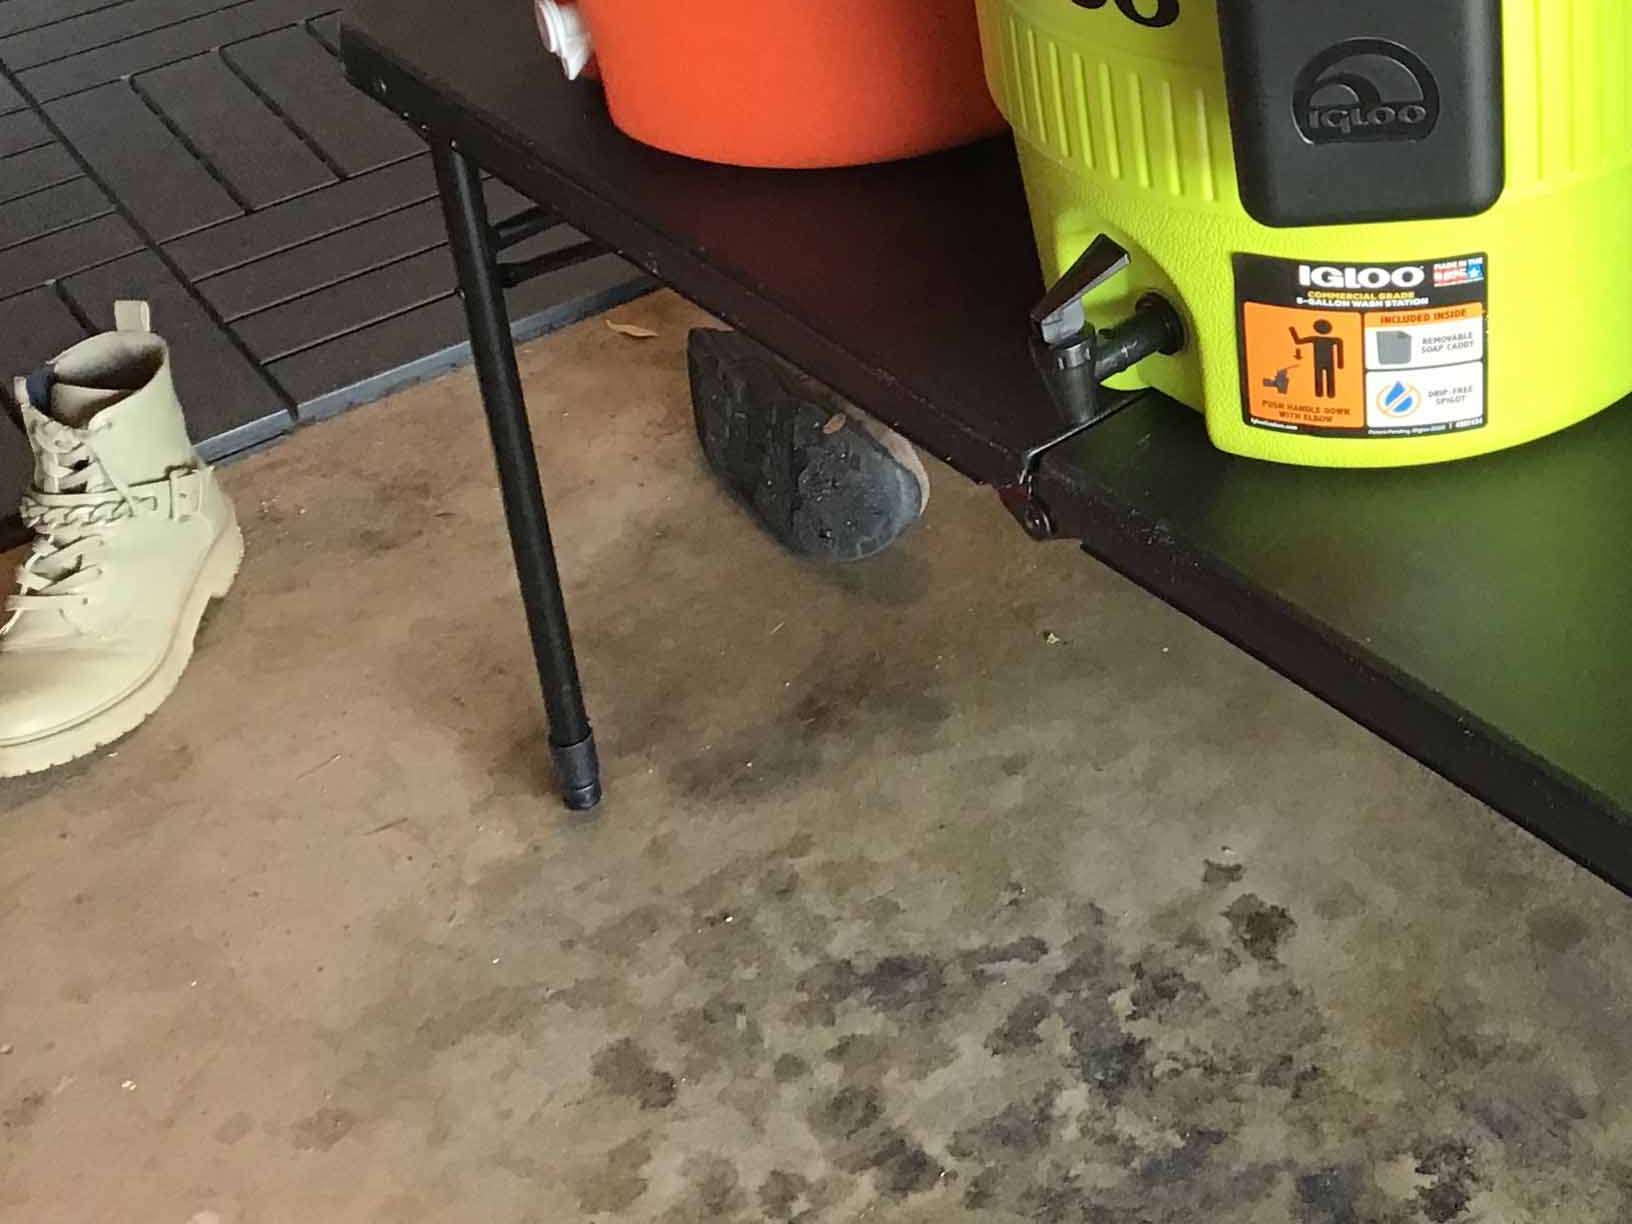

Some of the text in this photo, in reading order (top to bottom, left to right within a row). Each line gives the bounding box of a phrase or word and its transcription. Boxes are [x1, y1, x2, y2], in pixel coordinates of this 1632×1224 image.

[1309, 105, 1426, 133] IGLOO
[1298, 264, 1425, 288] IGLOO
[1307, 290, 1415, 301] COMMERCIAL GRADE
[1352, 300, 1383, 308] WASH
[1385, 297, 1429, 307] STATION
[1380, 309, 1466, 324] INCLUDED INSIDE
[1422, 331, 1473, 345] REMOVABLE
[1421, 344, 1444, 354] SOAP
[1262, 399, 1351, 416] PUSH HANDLE DOWN
[1303, 414, 1333, 423] ELBOW
